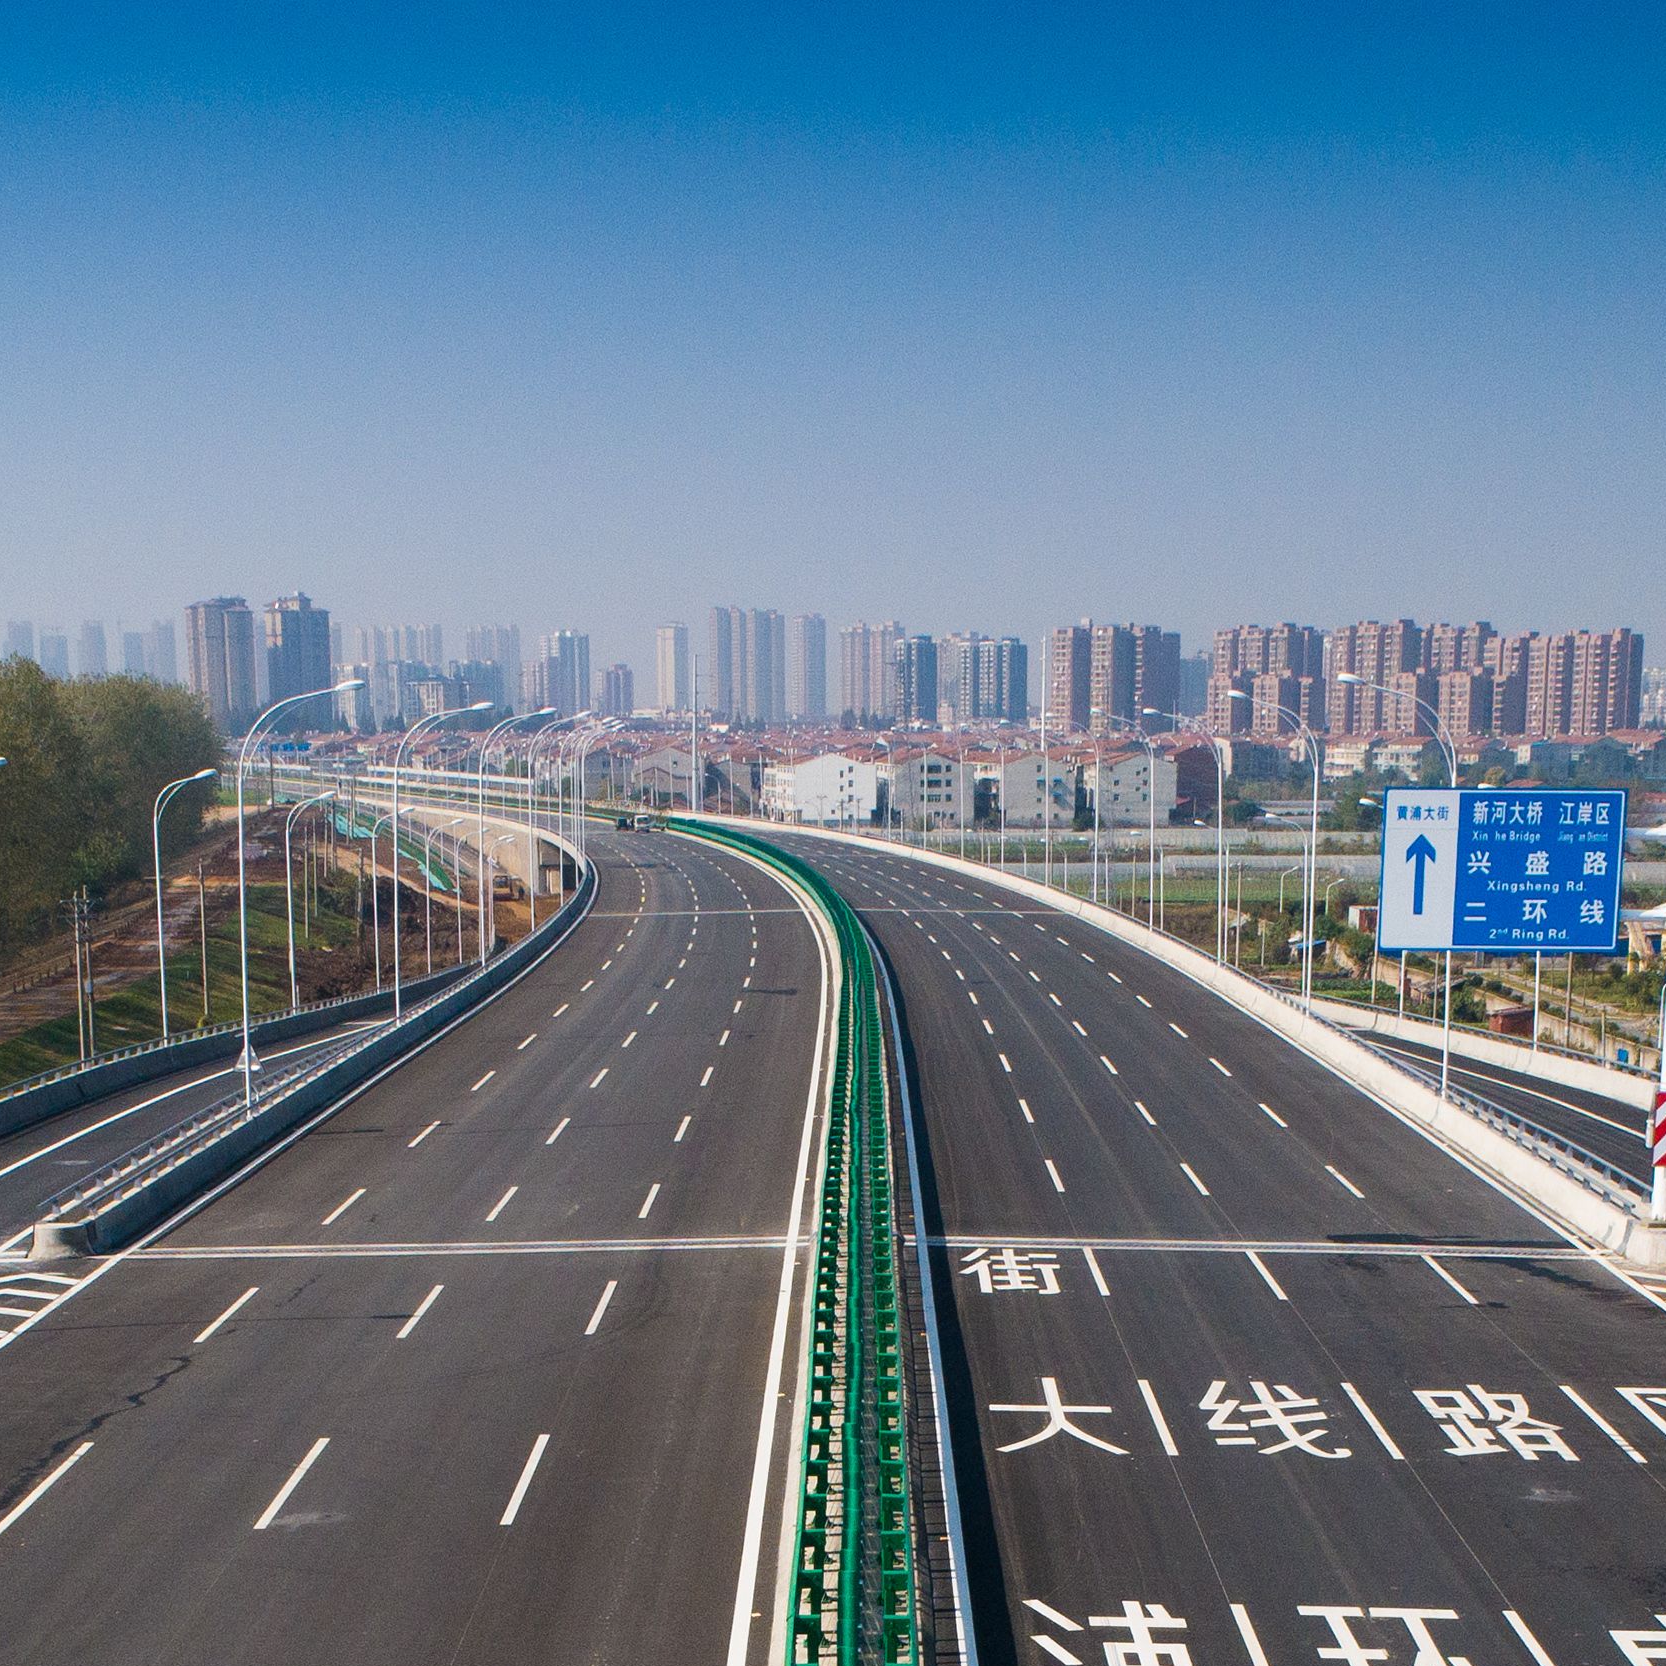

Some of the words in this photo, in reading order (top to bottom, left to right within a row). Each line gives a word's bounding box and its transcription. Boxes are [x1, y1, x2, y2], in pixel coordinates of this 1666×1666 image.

[1396, 805, 1450, 822] 黄浦大街
[1472, 800, 1543, 826] 新河大桥
[1559, 800, 1611, 826] 江岸区
[1509, 830, 1541, 844] Bridge
[1467, 850, 1609, 876] 兴盛路
[1486, 880, 1560, 894] Xingsheng
[1565, 880, 1587, 892] Rd.
[1463, 899, 1606, 926] 二环线
[1488, 928, 1509, 940] 2nd
[1511, 928, 1544, 941] Ring
[1548, 928, 1570, 940] Rd.
